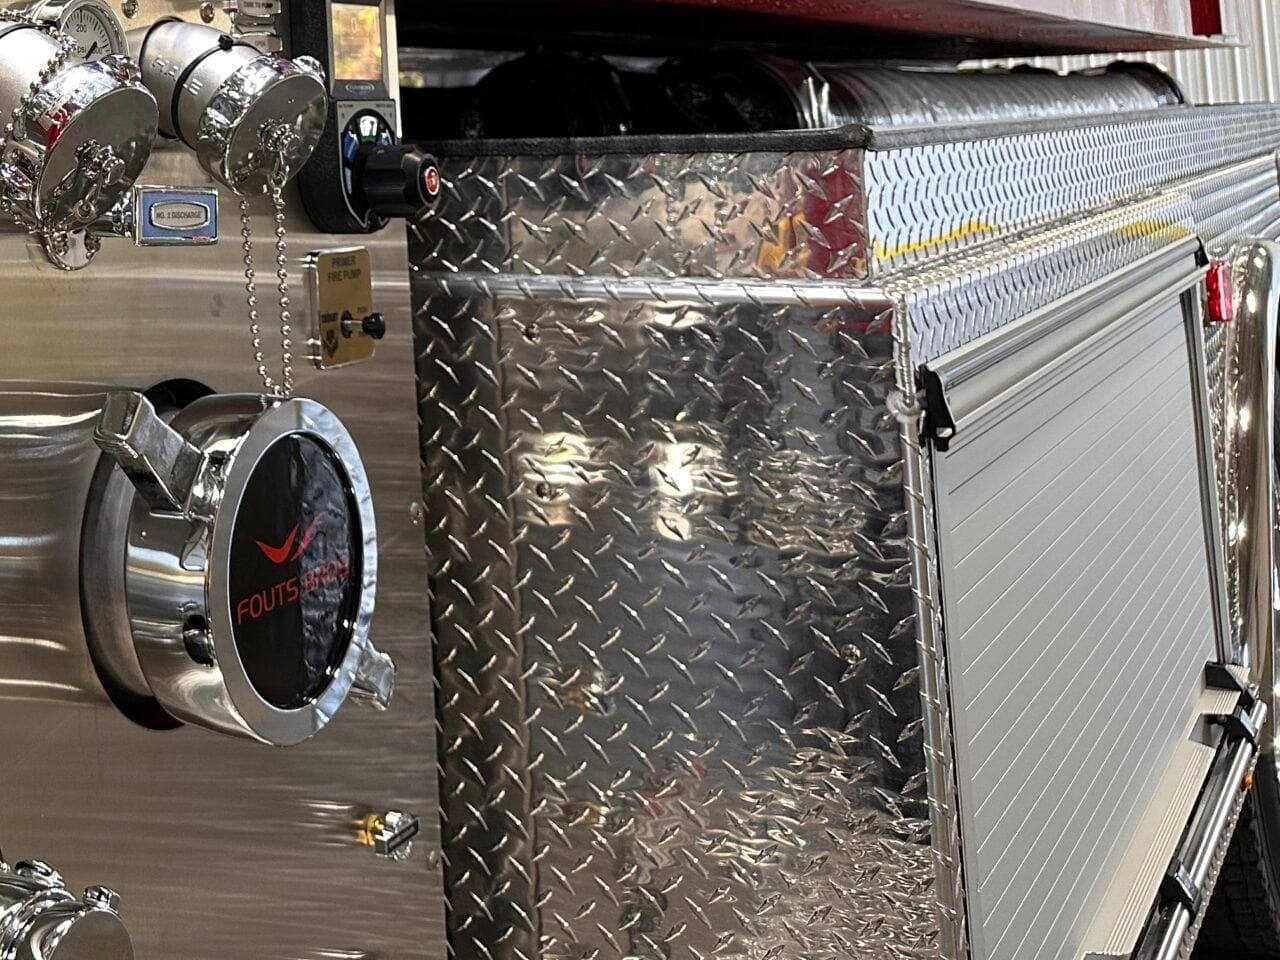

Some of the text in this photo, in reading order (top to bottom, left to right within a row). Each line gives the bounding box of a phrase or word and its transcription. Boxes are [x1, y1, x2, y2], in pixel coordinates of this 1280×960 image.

[172, 211, 201, 219] DISCHARGE
[327, 268, 361, 282] FIRE PUMP
[236, 556, 350, 625] FOUTS BROS
